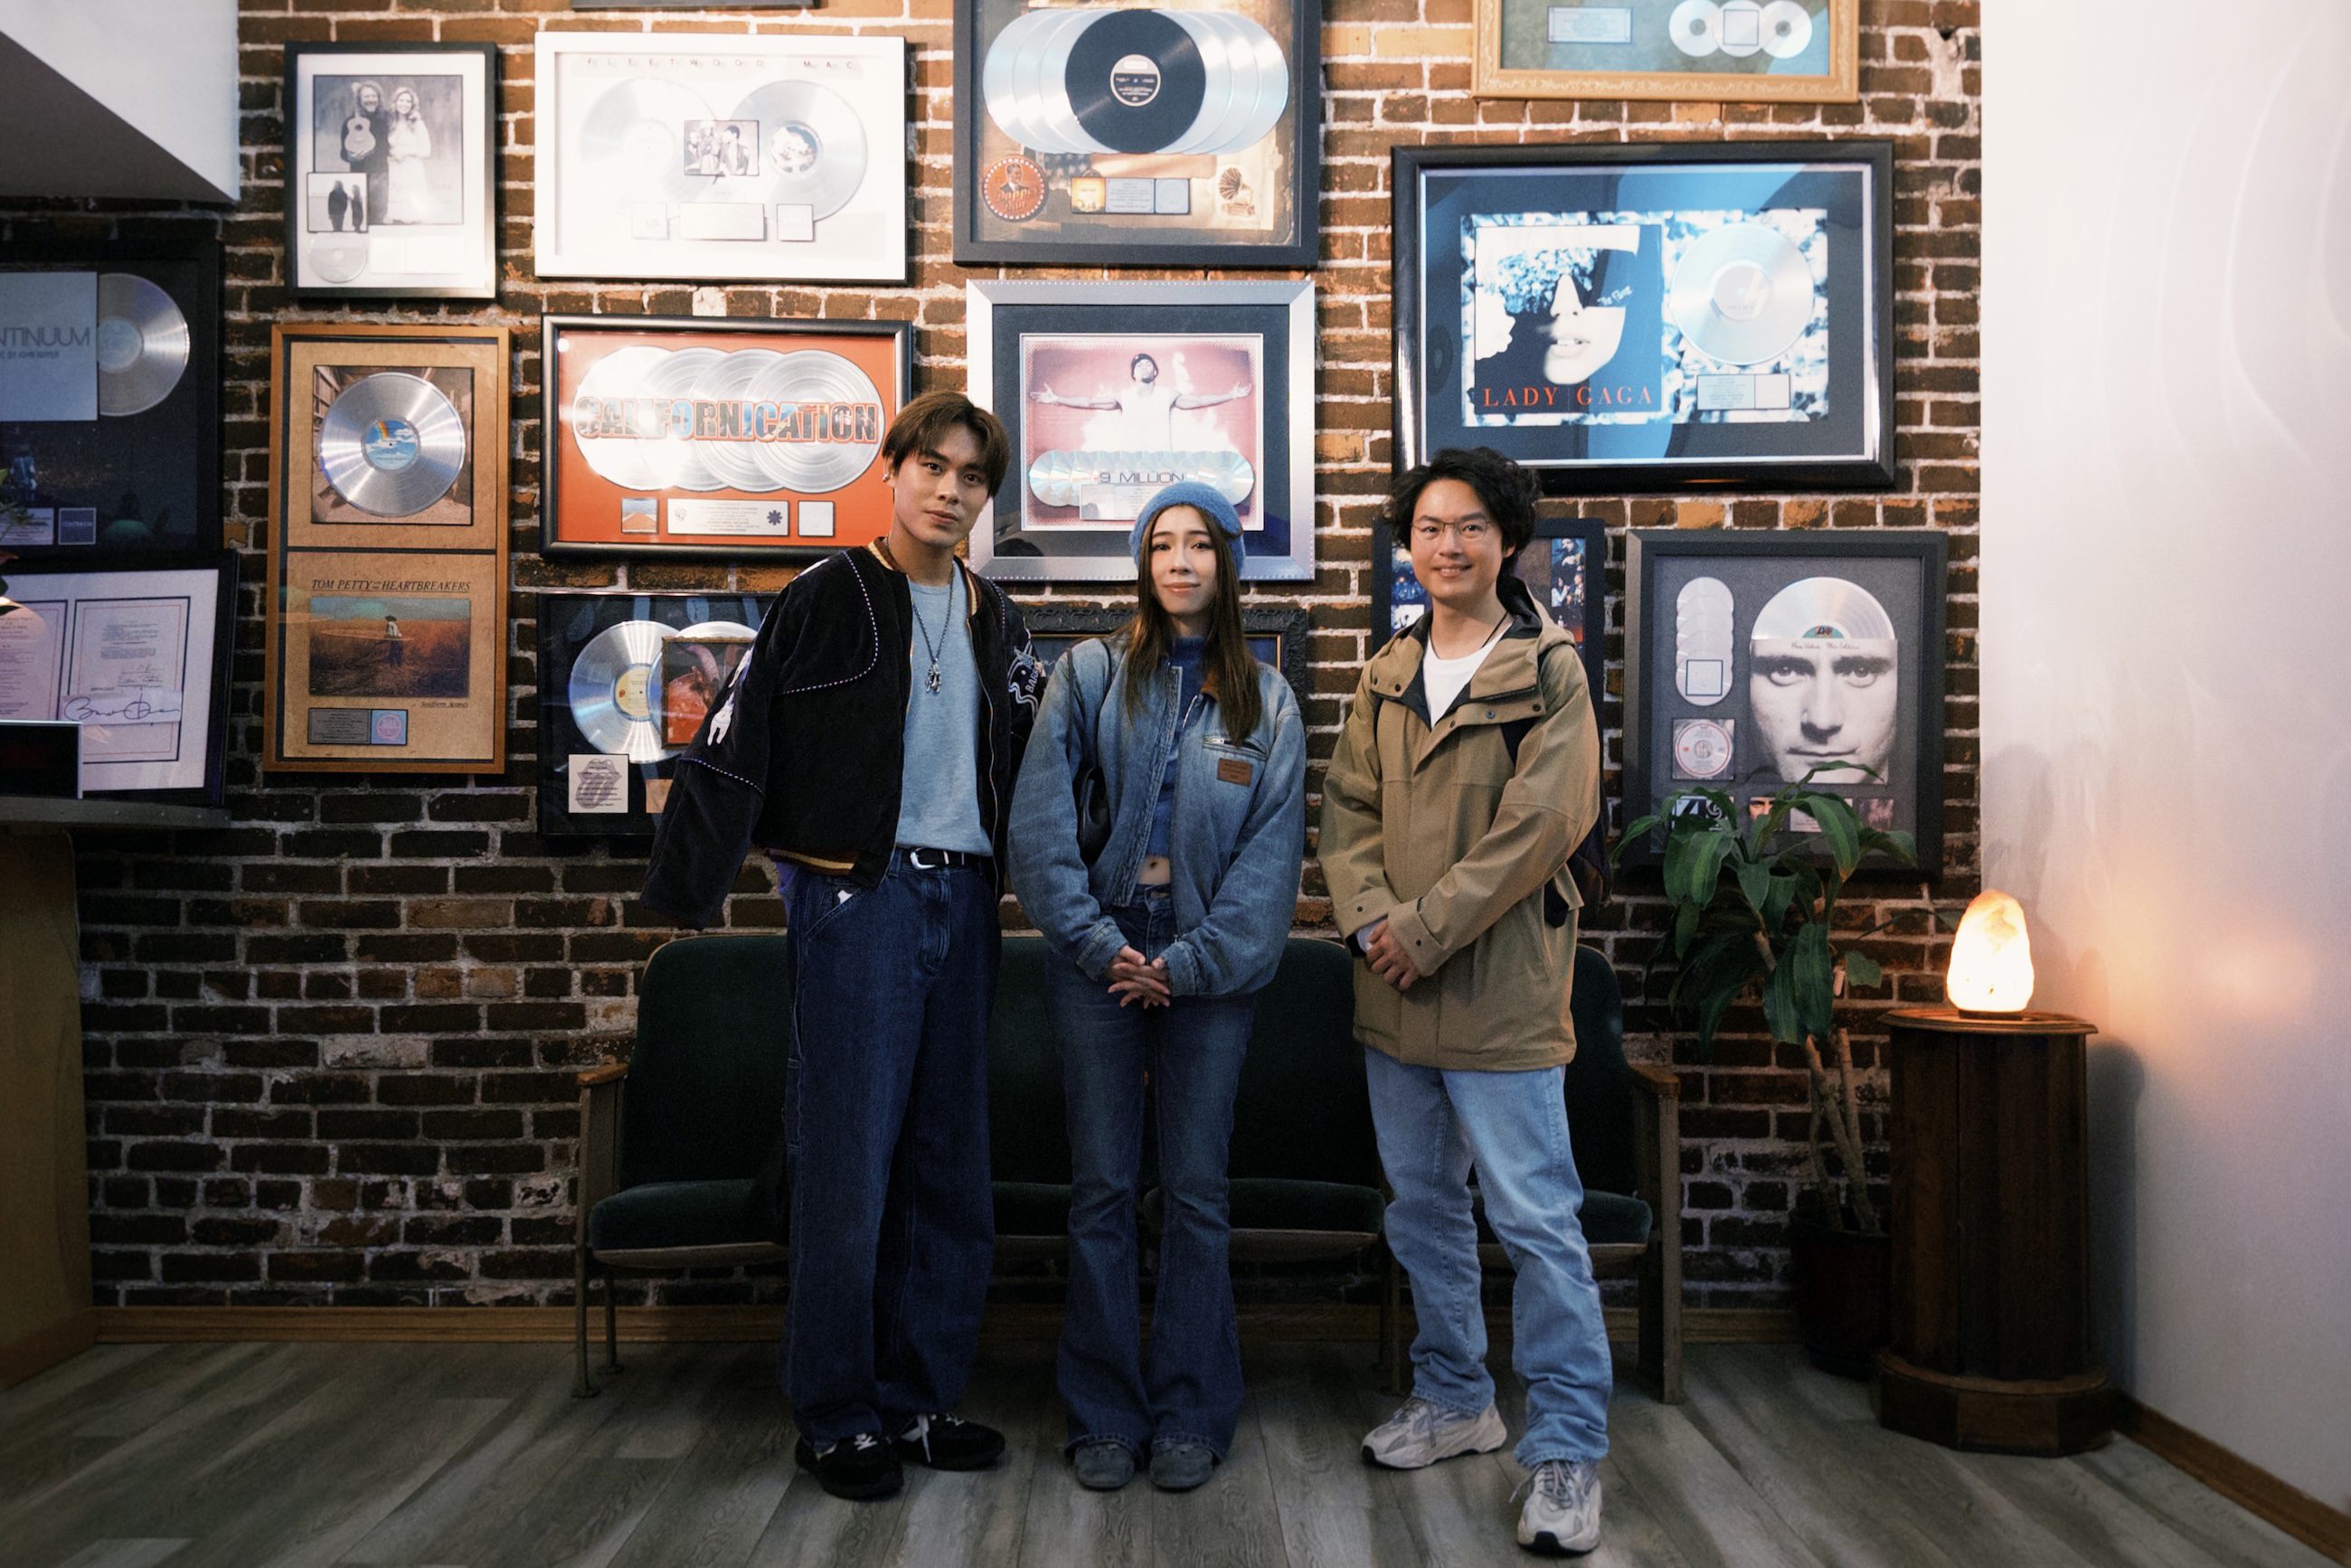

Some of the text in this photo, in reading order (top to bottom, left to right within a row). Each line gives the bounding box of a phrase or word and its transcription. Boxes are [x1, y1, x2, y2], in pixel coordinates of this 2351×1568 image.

[1483, 385, 1652, 407] LADY GAGA
[1100, 471, 1185, 484] 9 MILLION
[311, 578, 335, 590] TOM
[336, 579, 373, 590] PETTY
[382, 580, 471, 591] HEARTBREAKERS
